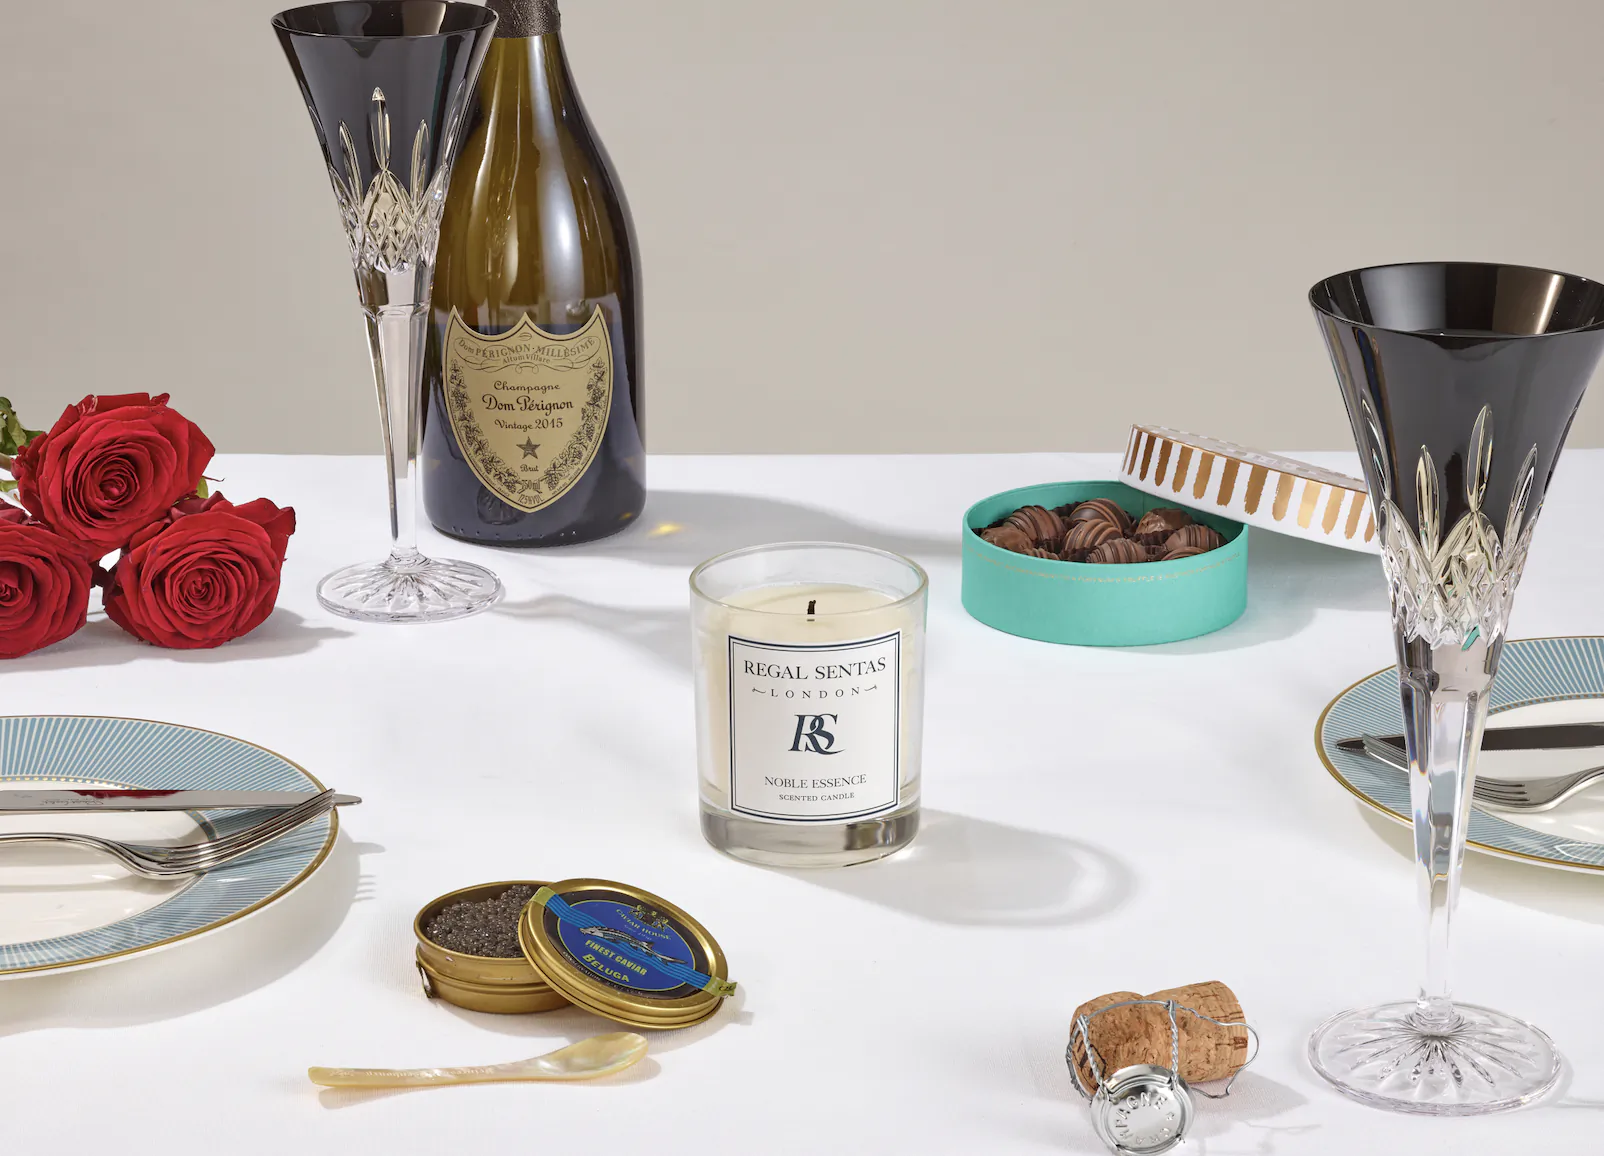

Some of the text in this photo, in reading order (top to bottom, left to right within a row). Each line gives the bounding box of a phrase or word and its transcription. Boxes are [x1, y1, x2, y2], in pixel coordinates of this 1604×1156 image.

[493, 380, 560, 394] Champagne
[481, 393, 515, 411] Dom
[516, 395, 574, 416] Pérignon
[494, 417, 563, 432] Vintage 2015
[520, 464, 539, 472] Brut
[744, 656, 886, 680] REGAL SENTAS
[771, 686, 860, 699] LONDON
[764, 773, 867, 789] NOBLE ESSENCE
[778, 791, 855, 802] SCENTED CANDLE
[585, 939, 615, 958] FINEST
[615, 955, 648, 976] CAVIAR
[582, 953, 630, 983] BELUGA
